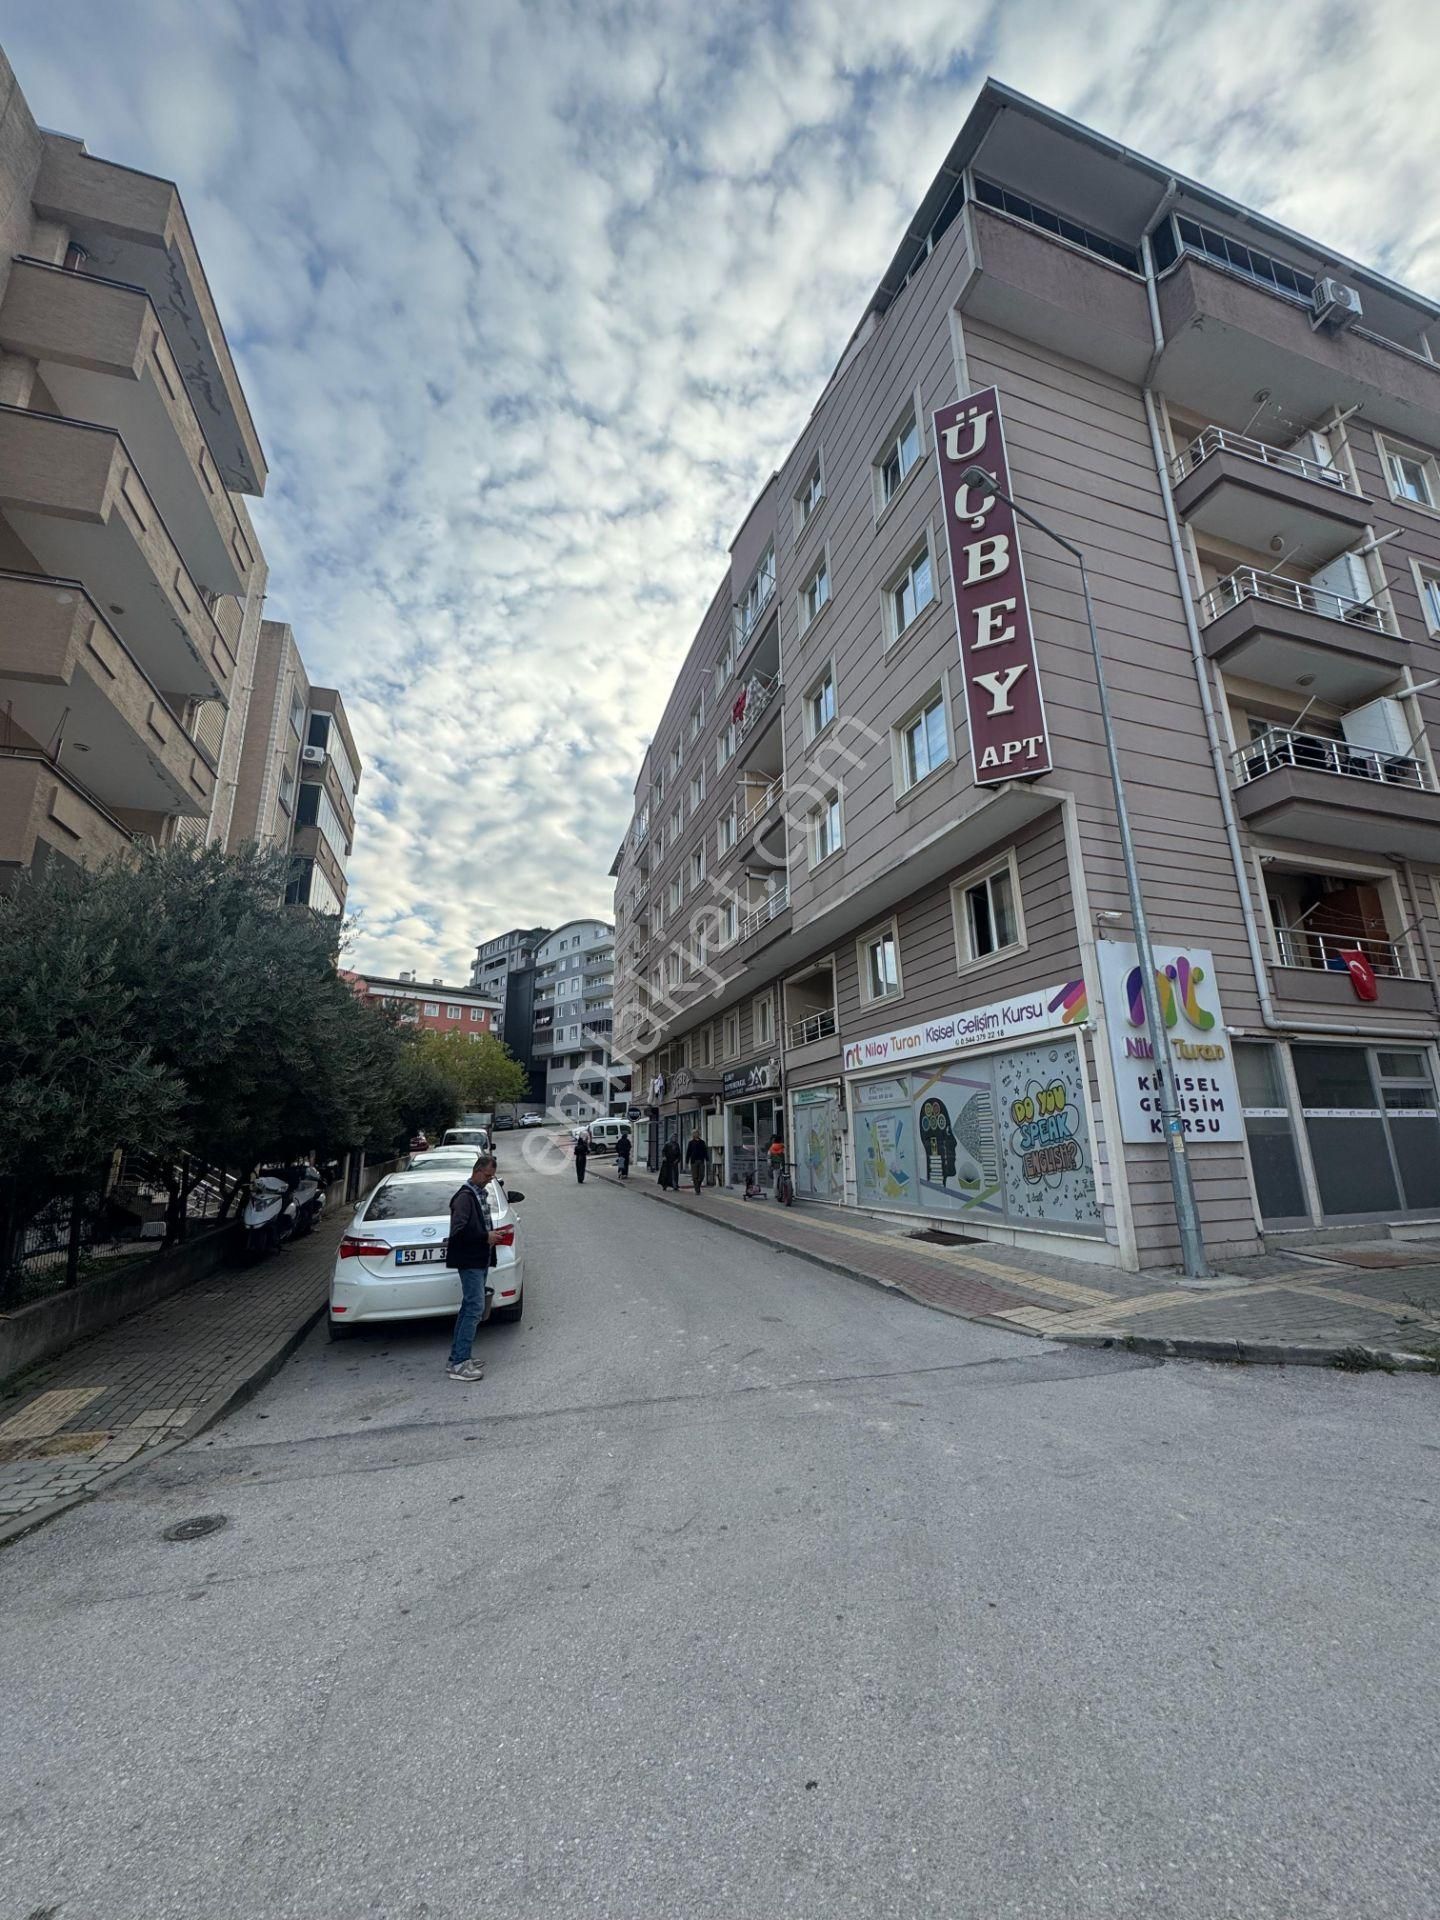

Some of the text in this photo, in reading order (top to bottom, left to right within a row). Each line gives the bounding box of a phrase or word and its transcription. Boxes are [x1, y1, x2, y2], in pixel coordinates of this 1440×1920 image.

[941, 405, 1028, 718] ÜÇBEY
[979, 735, 1044, 769] APT
[865, 1042, 888, 1058] Nilay
[890, 1034, 921, 1052] Turan
[926, 1022, 955, 1044] Kişisel
[957, 1013, 999, 1036] Gelişim
[1002, 1003, 1043, 1026] Kursu
[1171, 1038, 1225, 1061] Turan
[1137, 1073, 1220, 1092] KİİSEL
[1012, 1085, 1067, 1126] DO YOU
[1139, 1094, 1225, 1114] GEİŞİM
[1020, 1111, 1073, 1151] SPEAK
[1150, 1118, 1221, 1134] KRSU
[1022, 1141, 1078, 1180] ENGLISH?
[404, 1250, 416, 1262] 59
[422, 1248, 434, 1261] AT
